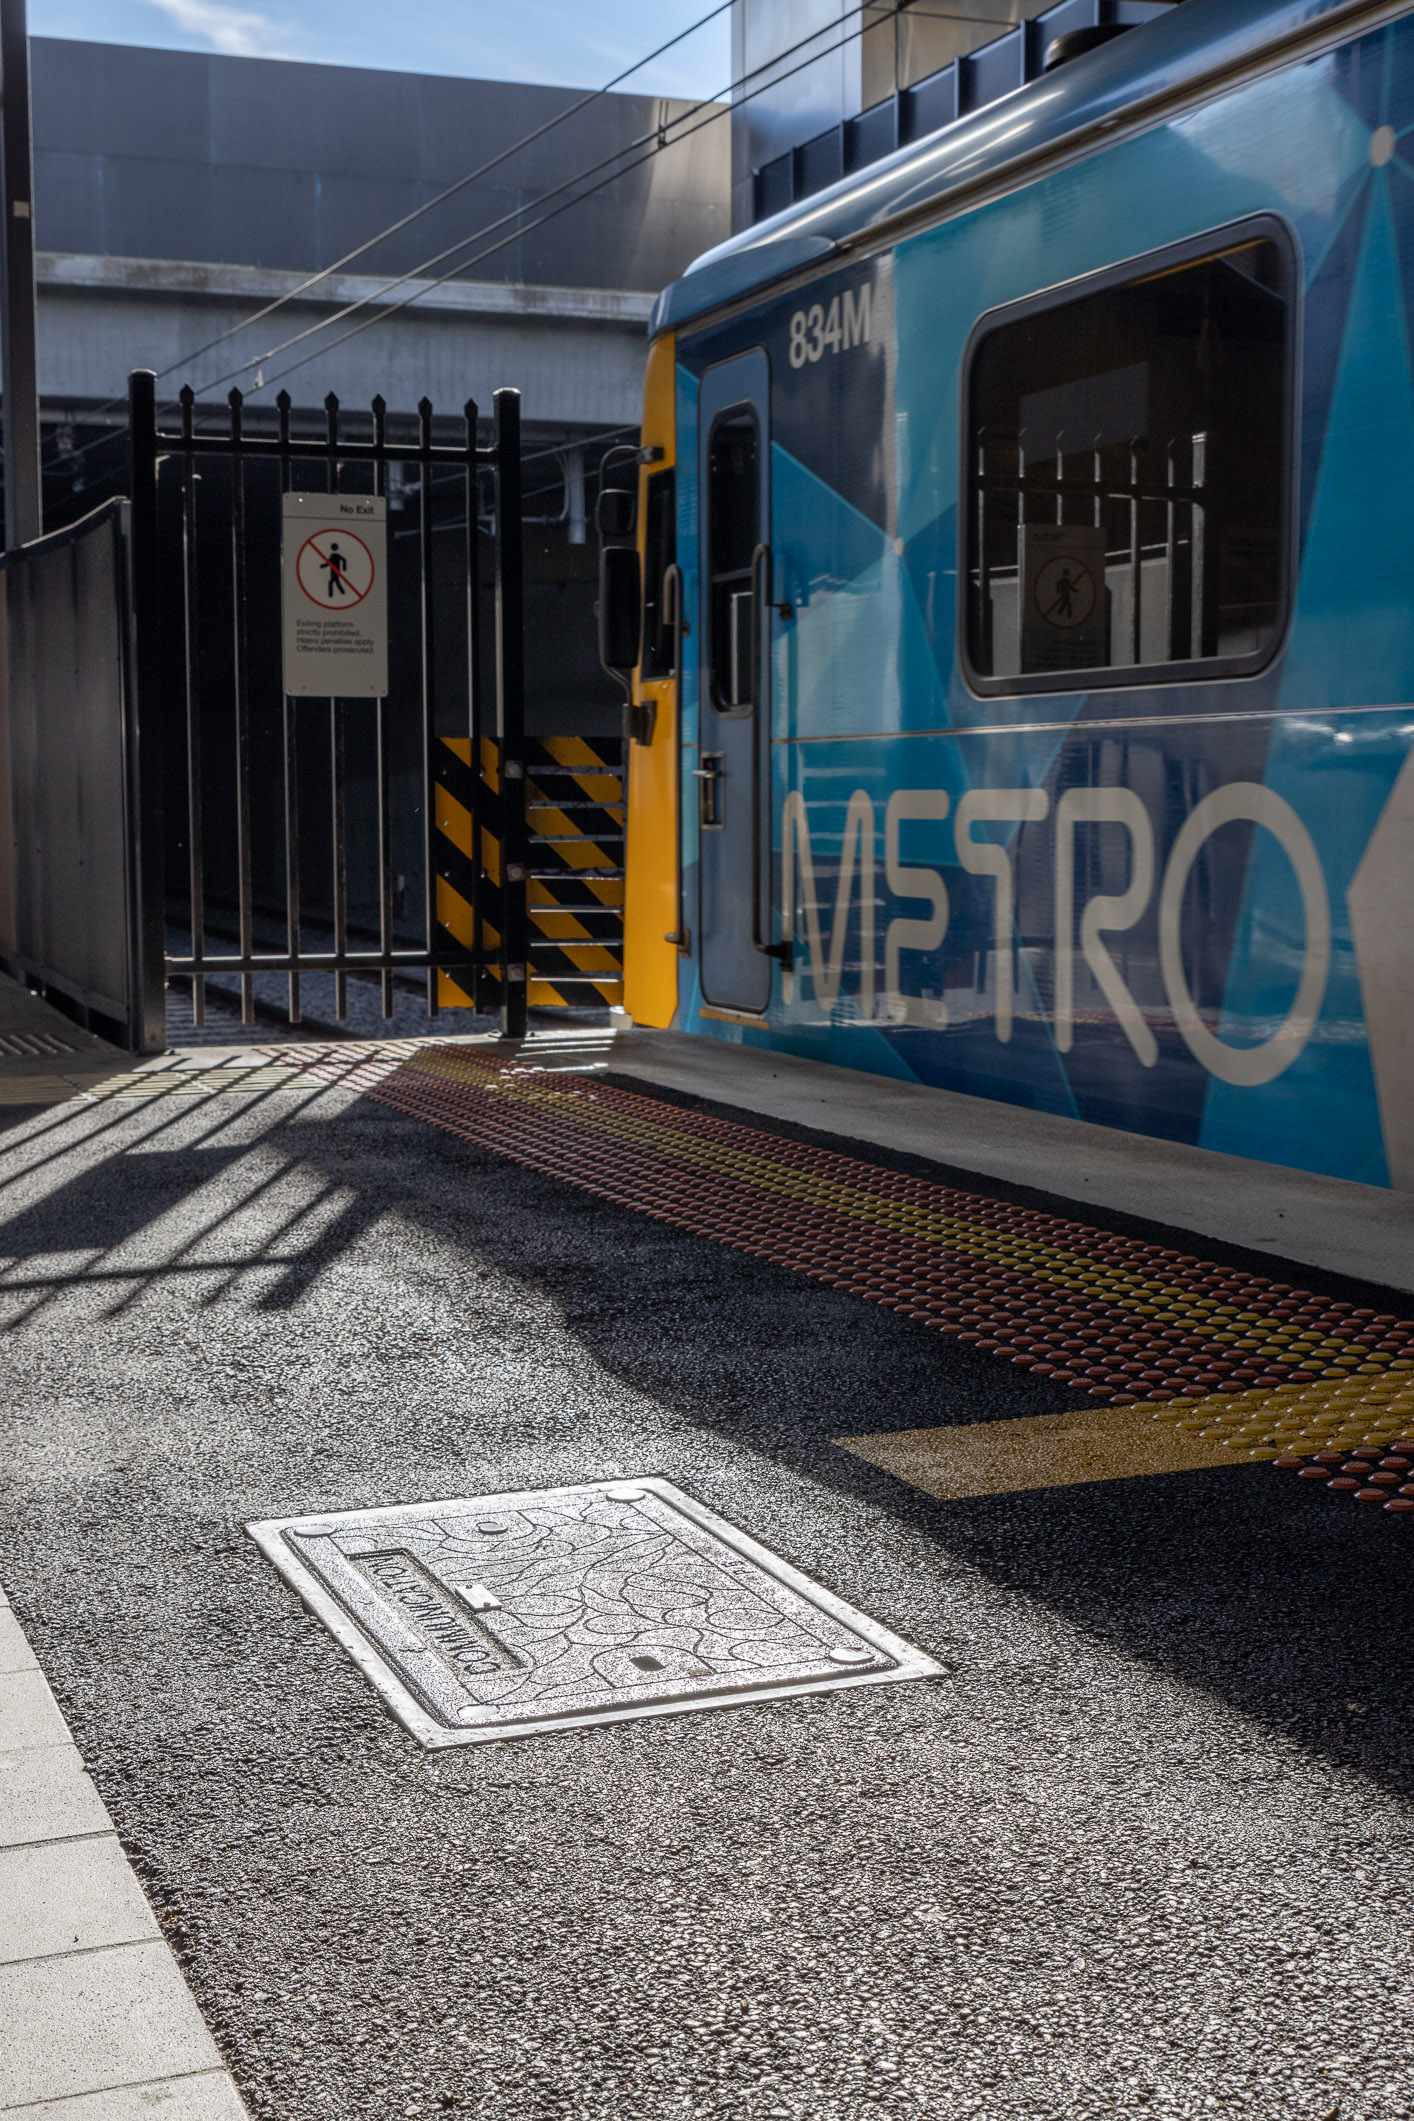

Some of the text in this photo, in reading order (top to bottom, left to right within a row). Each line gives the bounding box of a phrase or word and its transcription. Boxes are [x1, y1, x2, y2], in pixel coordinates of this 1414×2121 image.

[789, 282, 871, 369] 834M
[340, 504, 374, 515] No Exit
[296, 619, 354, 629] Exiting platform
[296, 629, 321, 637] strictly
[296, 637, 319, 645] Heavy
[321, 638, 353, 646] penalties
[296, 645, 332, 653] Offenders
[782, 782, 1331, 1086] METRO
[362, 1556, 502, 1675] COMMUNICATION
